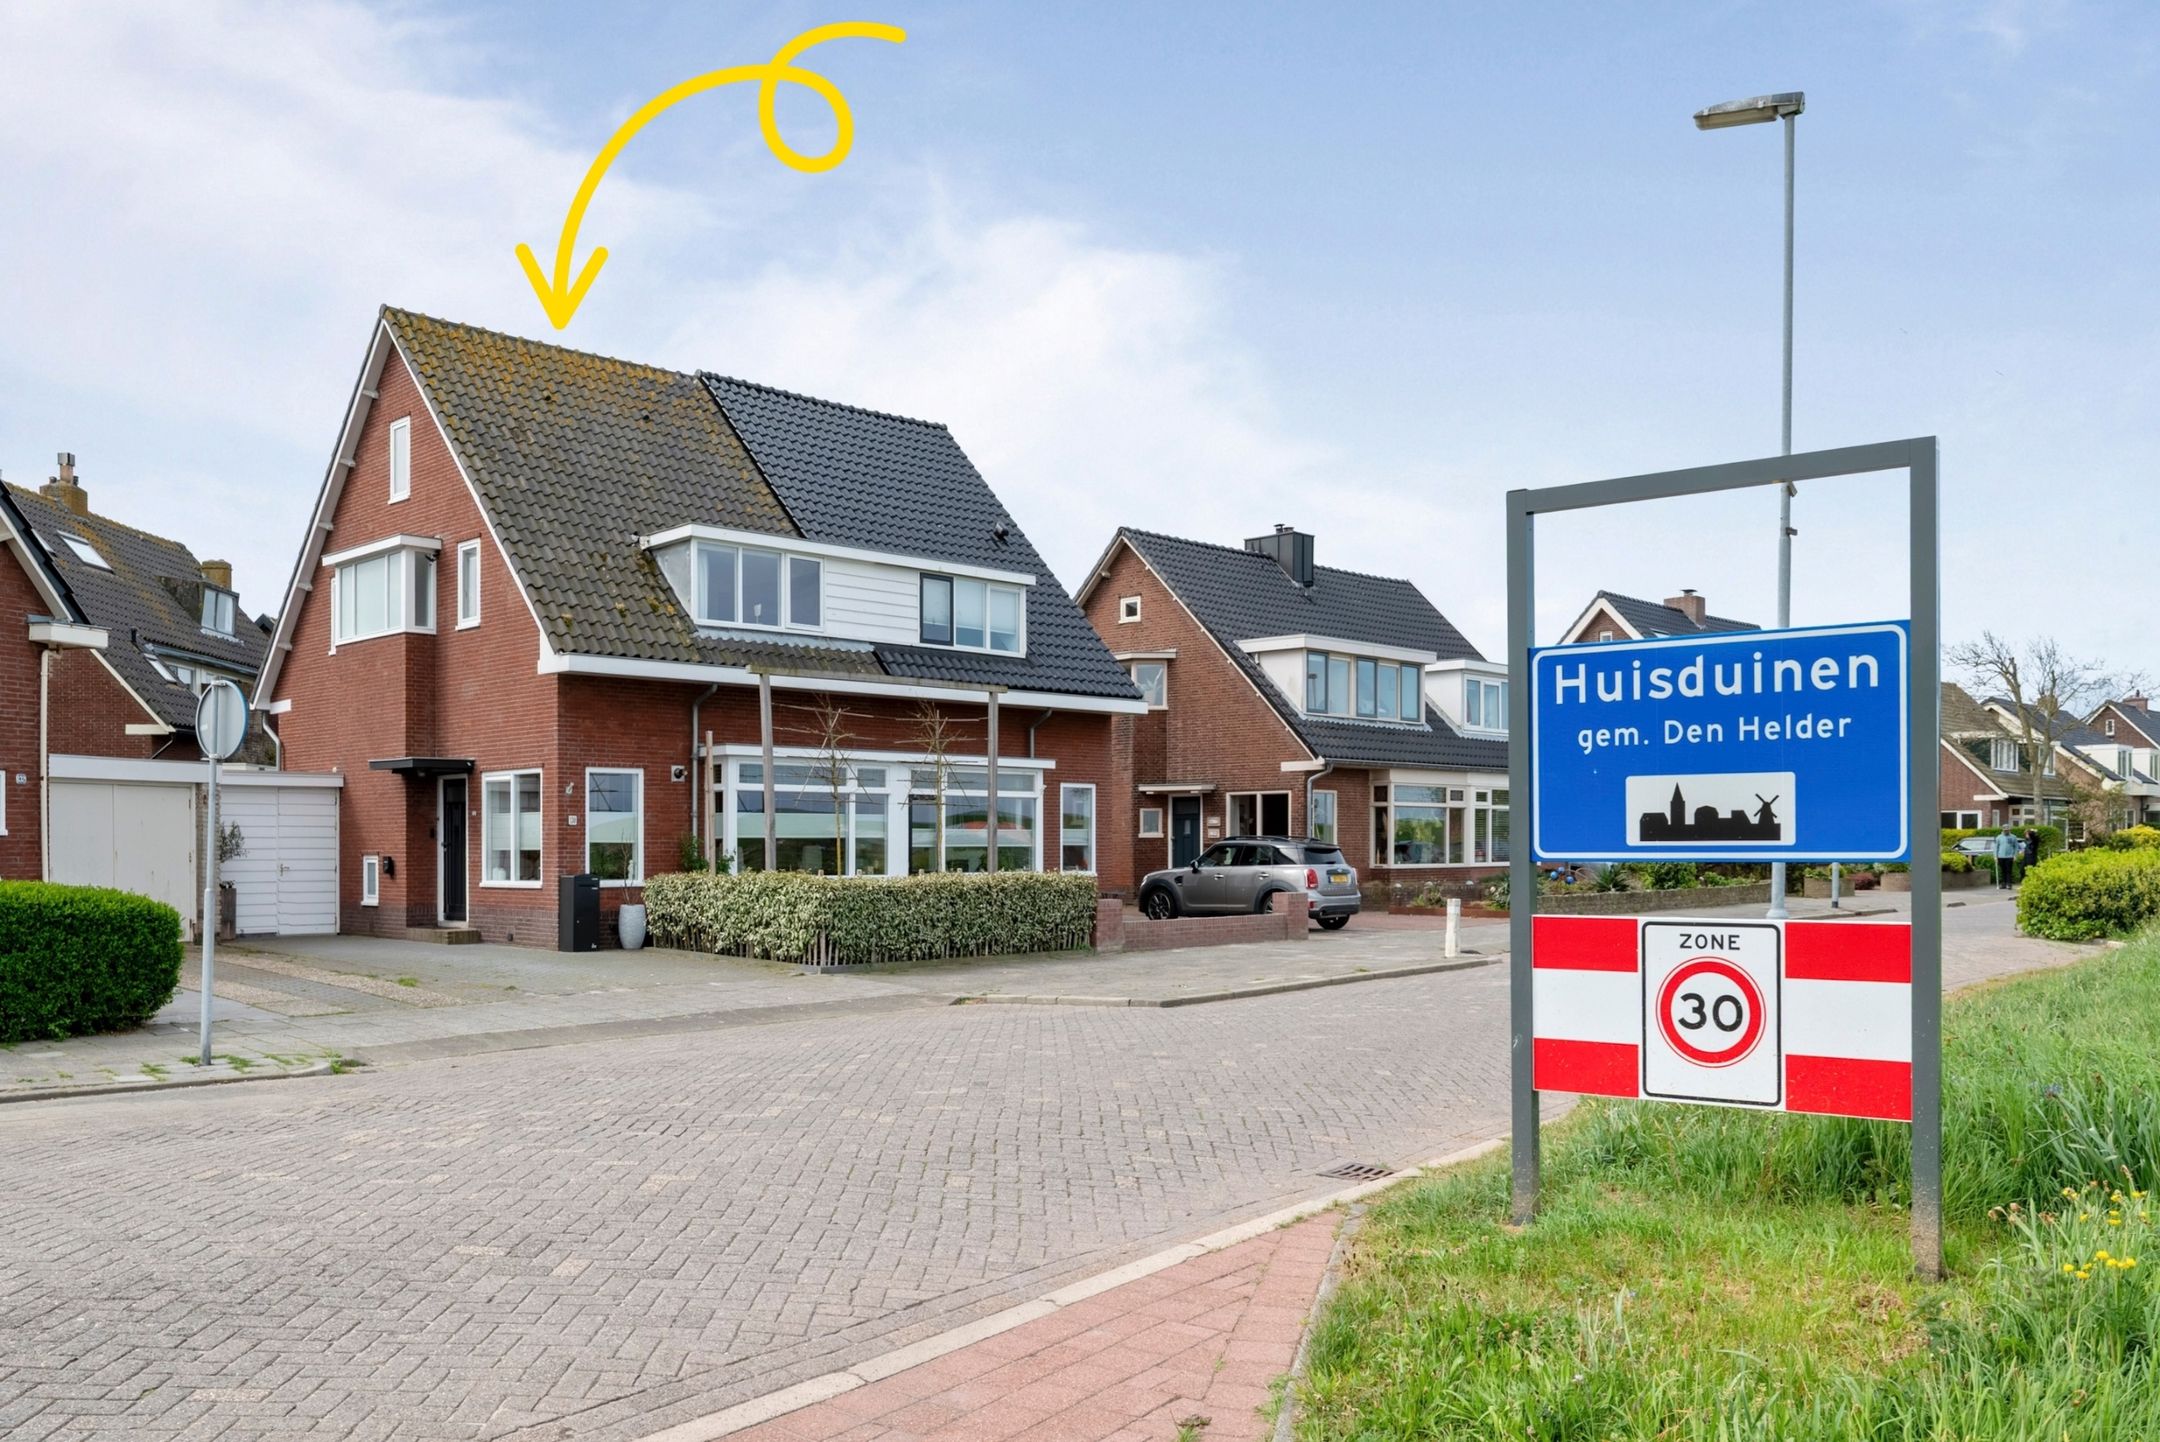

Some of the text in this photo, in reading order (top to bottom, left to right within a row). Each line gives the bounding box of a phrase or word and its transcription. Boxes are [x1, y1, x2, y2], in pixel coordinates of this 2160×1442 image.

[1555, 651, 1879, 705] Huisduinen
[1578, 713, 1852, 755] gem. Den Helder
[1679, 933, 1741, 951] ZONE
[1678, 992, 1743, 1032] 30
